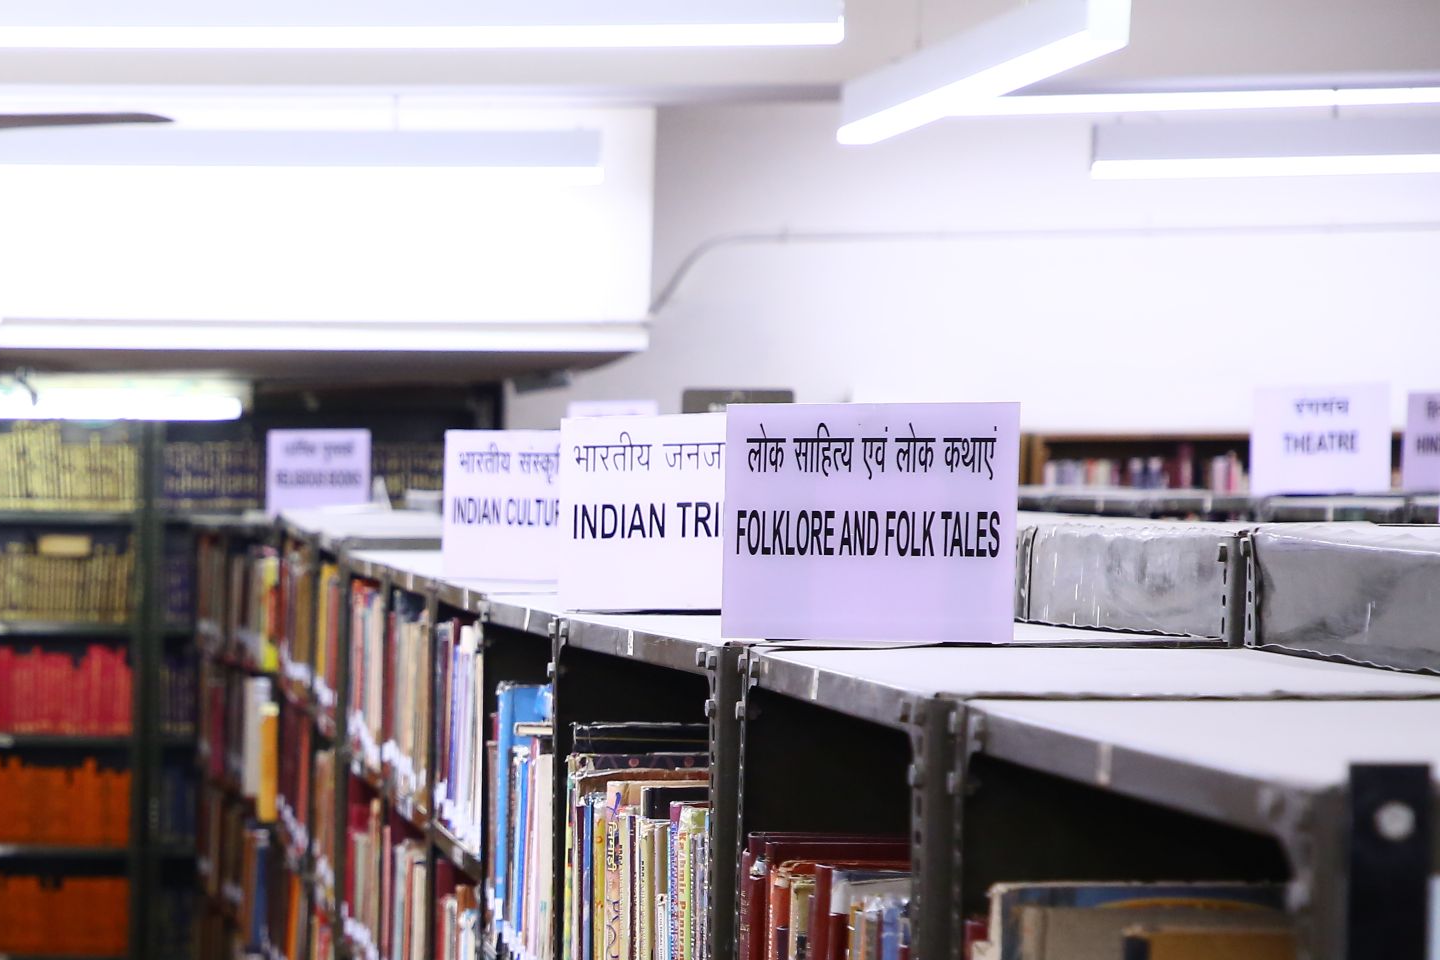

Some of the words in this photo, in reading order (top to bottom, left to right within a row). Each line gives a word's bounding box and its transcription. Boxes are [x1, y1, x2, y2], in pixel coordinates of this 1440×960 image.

[459, 442, 511, 474] भारतीय
[573, 431, 653, 473] भारतीय
[662, 442, 726, 471] जनज
[746, 422, 787, 473] लोक
[792, 422, 855, 478] साहित्य
[861, 426, 889, 481] एवं
[894, 422, 937, 473] लोक
[942, 425, 998, 481] कथाएं
[1283, 430, 1357, 454] THEATRE
[453, 497, 501, 526] INDIAN
[506, 497, 560, 527] CULTUR
[573, 502, 666, 540] INDIAN
[676, 501, 723, 539] TRI
[736, 509, 836, 556] FOLKLORE
[838, 510, 880, 557] AND
[884, 510, 936, 558] FOLK
[940, 510, 1001, 558] TALES
